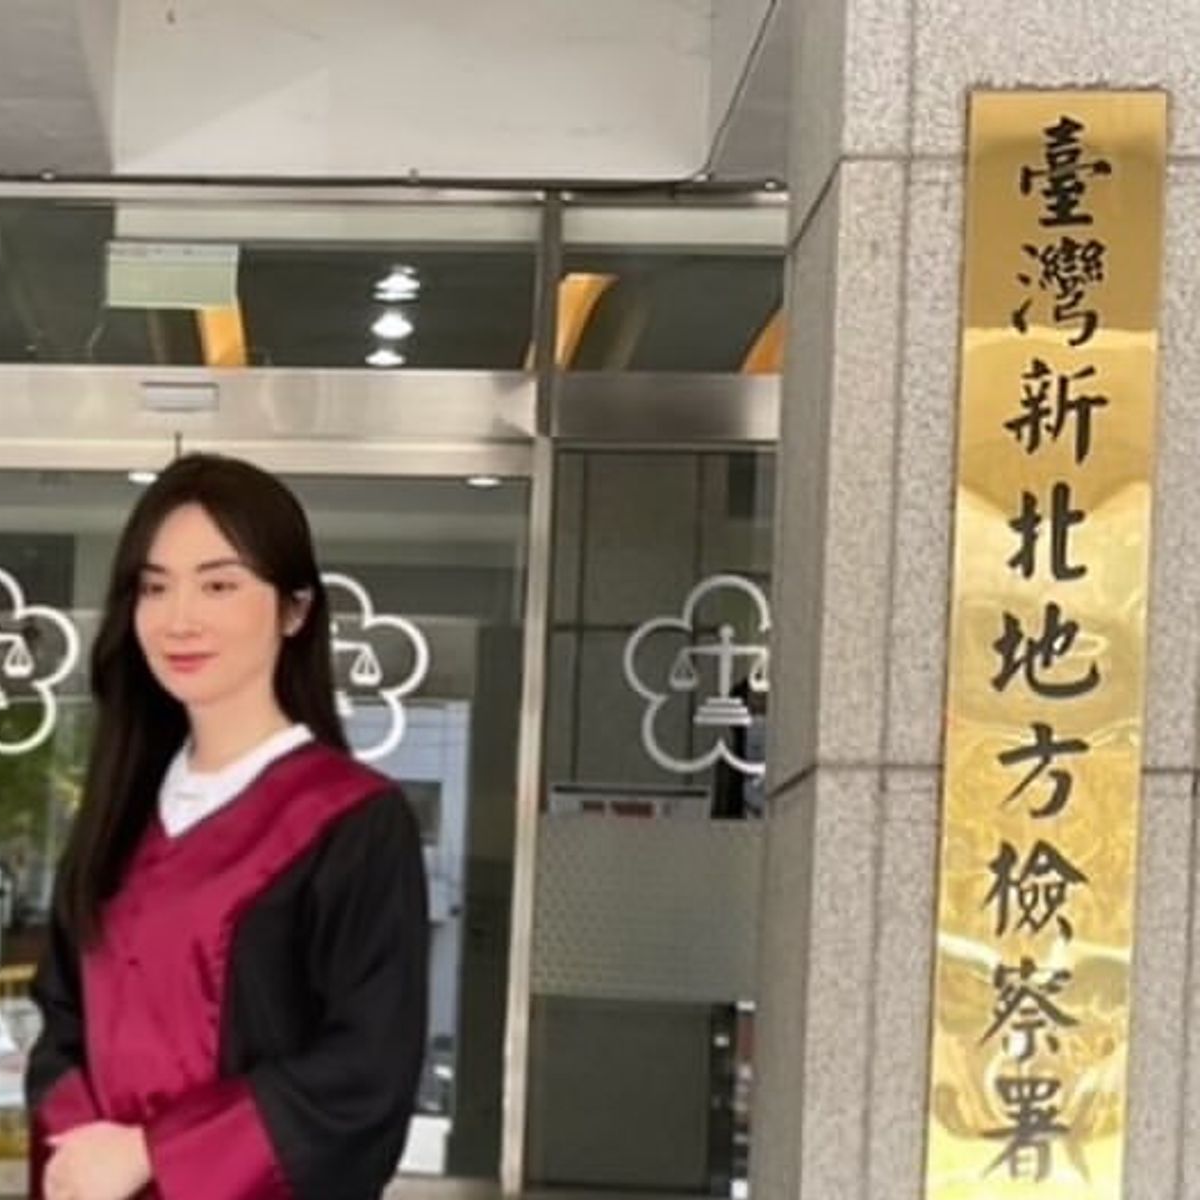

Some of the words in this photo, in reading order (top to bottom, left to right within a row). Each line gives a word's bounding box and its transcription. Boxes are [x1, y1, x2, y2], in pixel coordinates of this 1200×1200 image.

[978, 116, 1112, 1185] 臺灣新北地方檢察署
